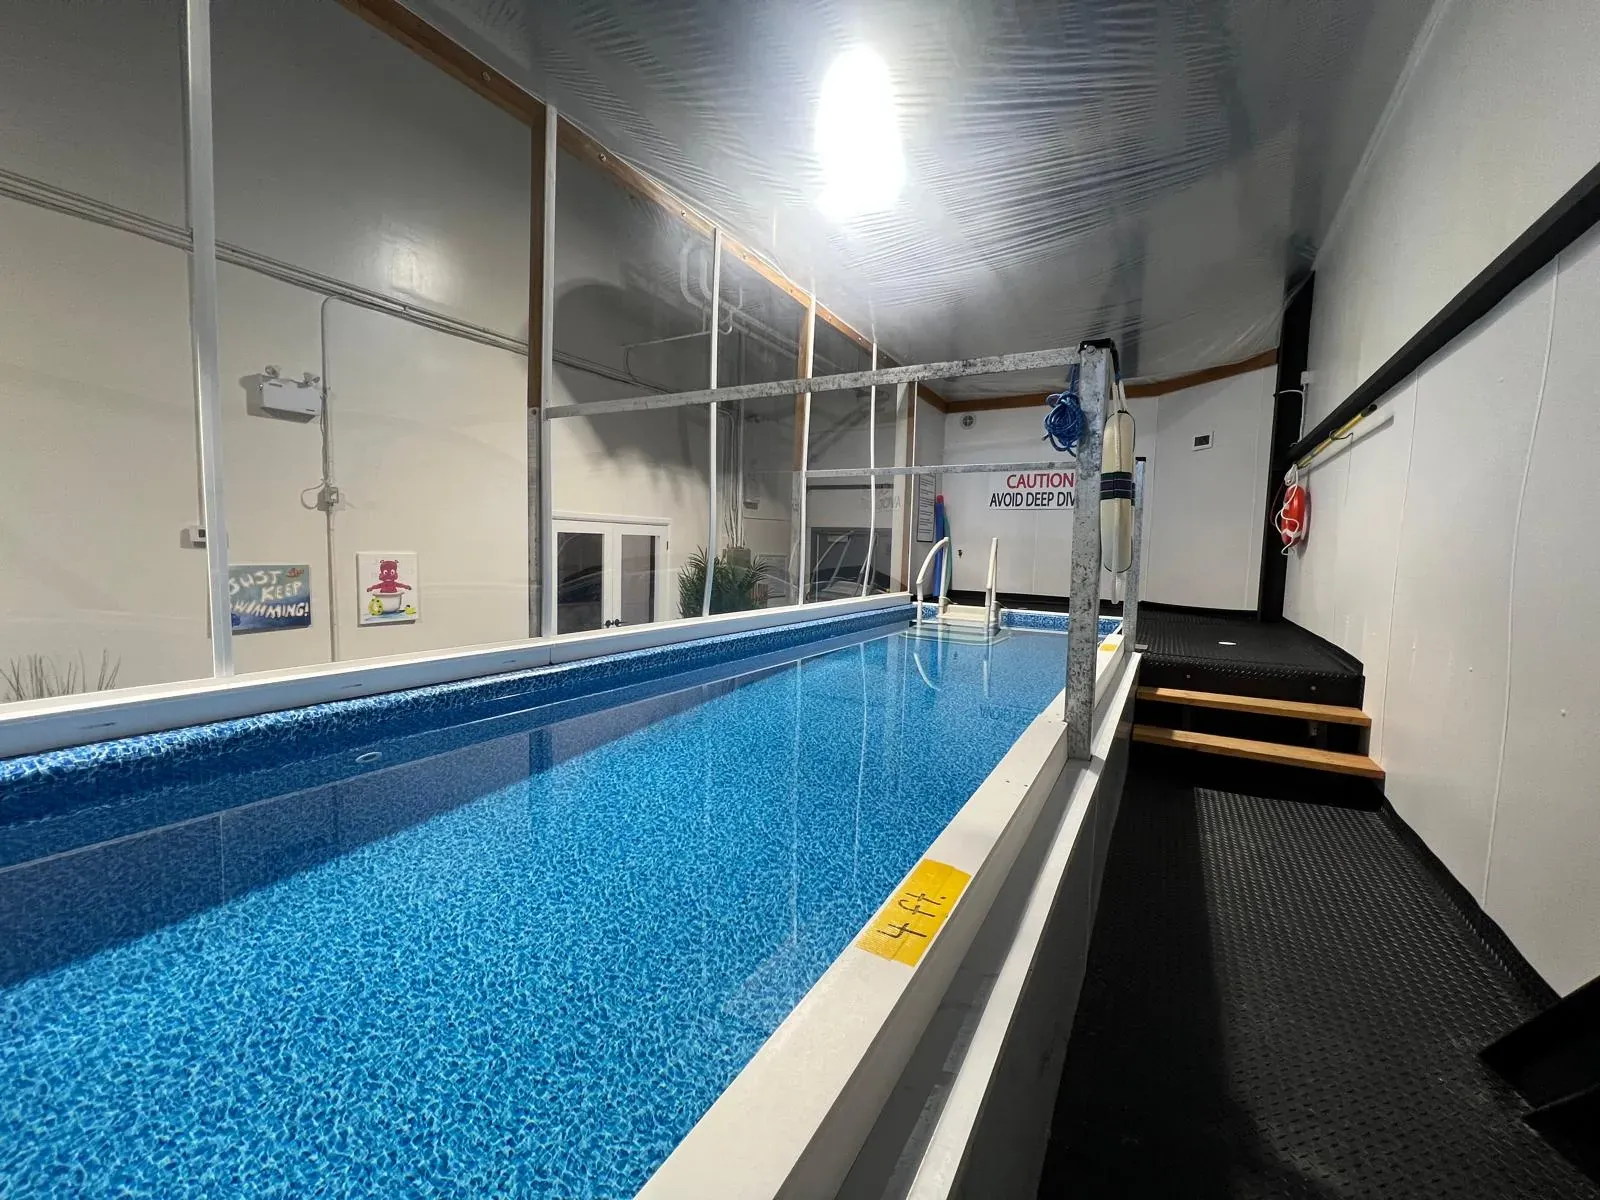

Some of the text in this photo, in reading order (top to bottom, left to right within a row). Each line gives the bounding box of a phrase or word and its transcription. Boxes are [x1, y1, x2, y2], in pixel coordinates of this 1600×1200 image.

[1007, 473, 1074, 489] CAUTION
[990, 493, 1023, 507] AVOID
[1026, 492, 1054, 507] DEEP
[261, 581, 301, 602] KEEP
[230, 600, 309, 618] WIMMING!
[876, 922, 927, 939] 4
